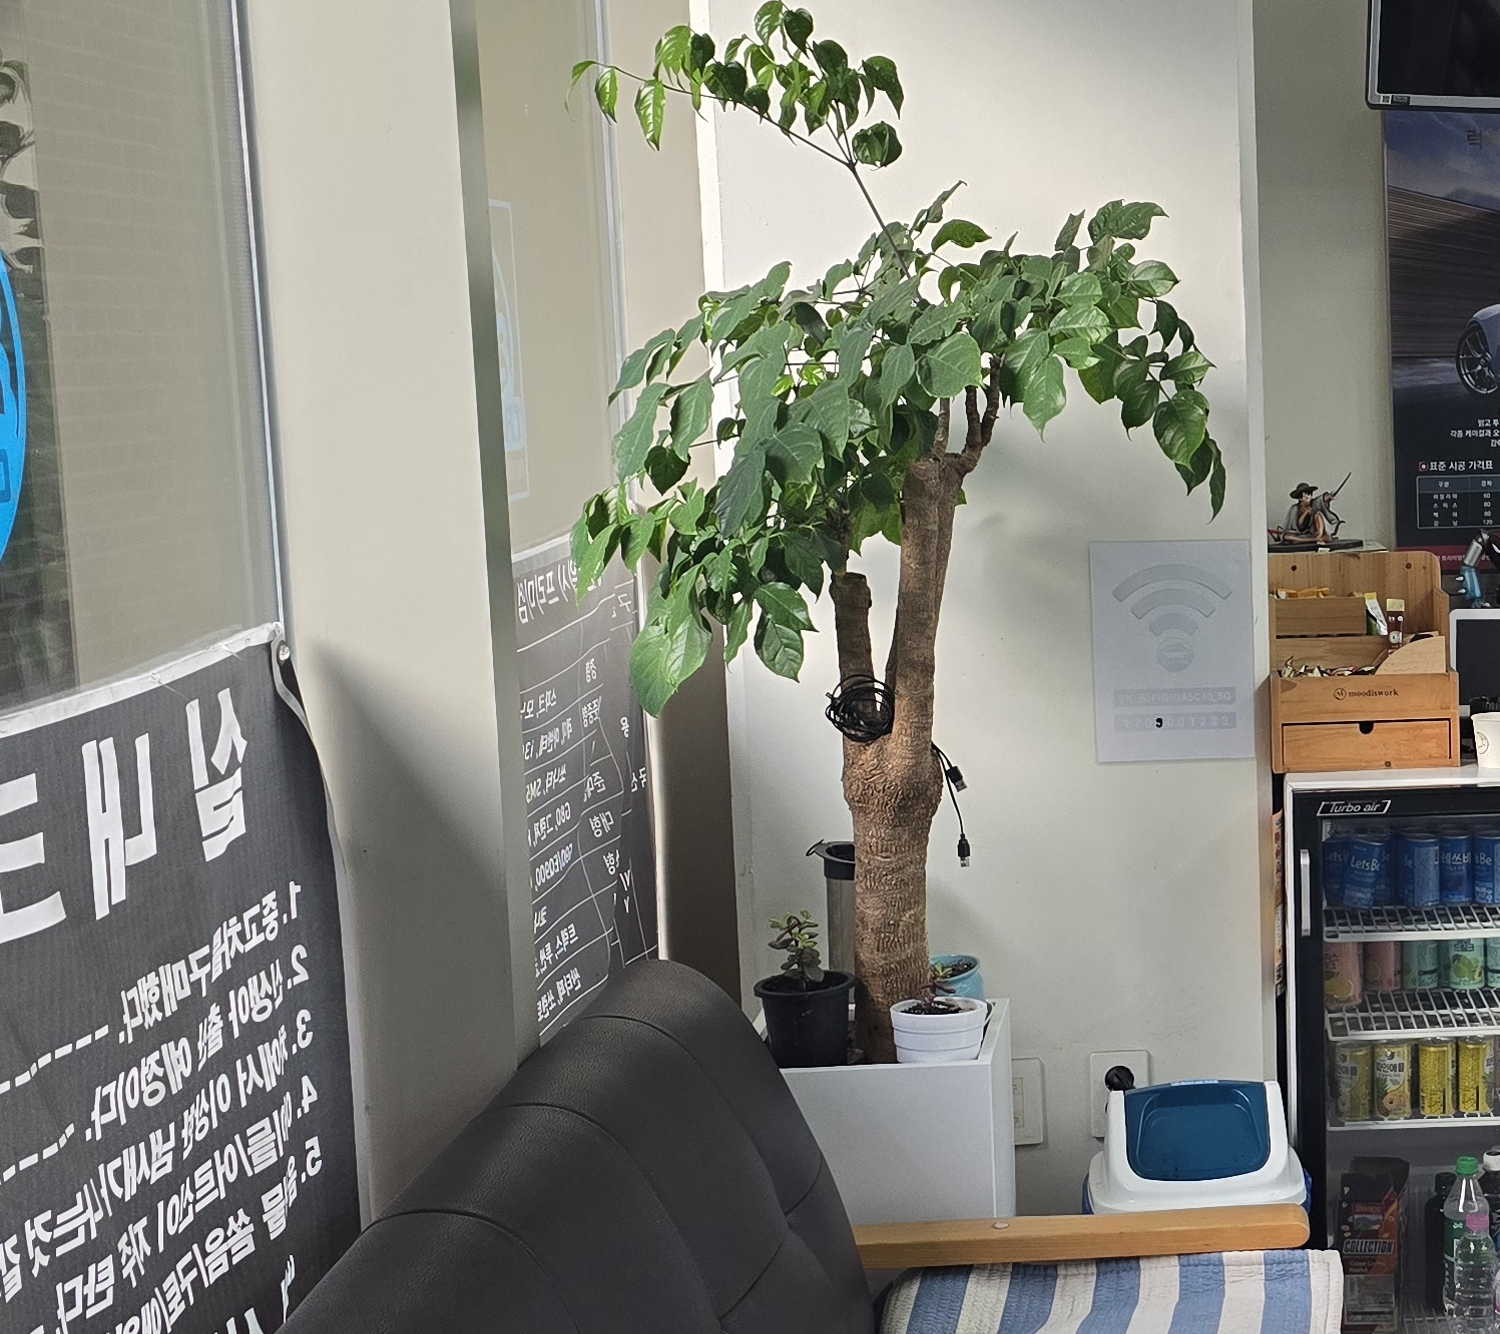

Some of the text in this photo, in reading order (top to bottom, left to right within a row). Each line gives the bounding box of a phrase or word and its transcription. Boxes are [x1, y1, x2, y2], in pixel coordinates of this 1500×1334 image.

[1429, 459, 1493, 471] 표준 시공 가격표
[1349, 688, 1399, 699] moodiswork
[1328, 802, 1381, 813] Turbo air
[1343, 1239, 1394, 1255] COLLECTION
